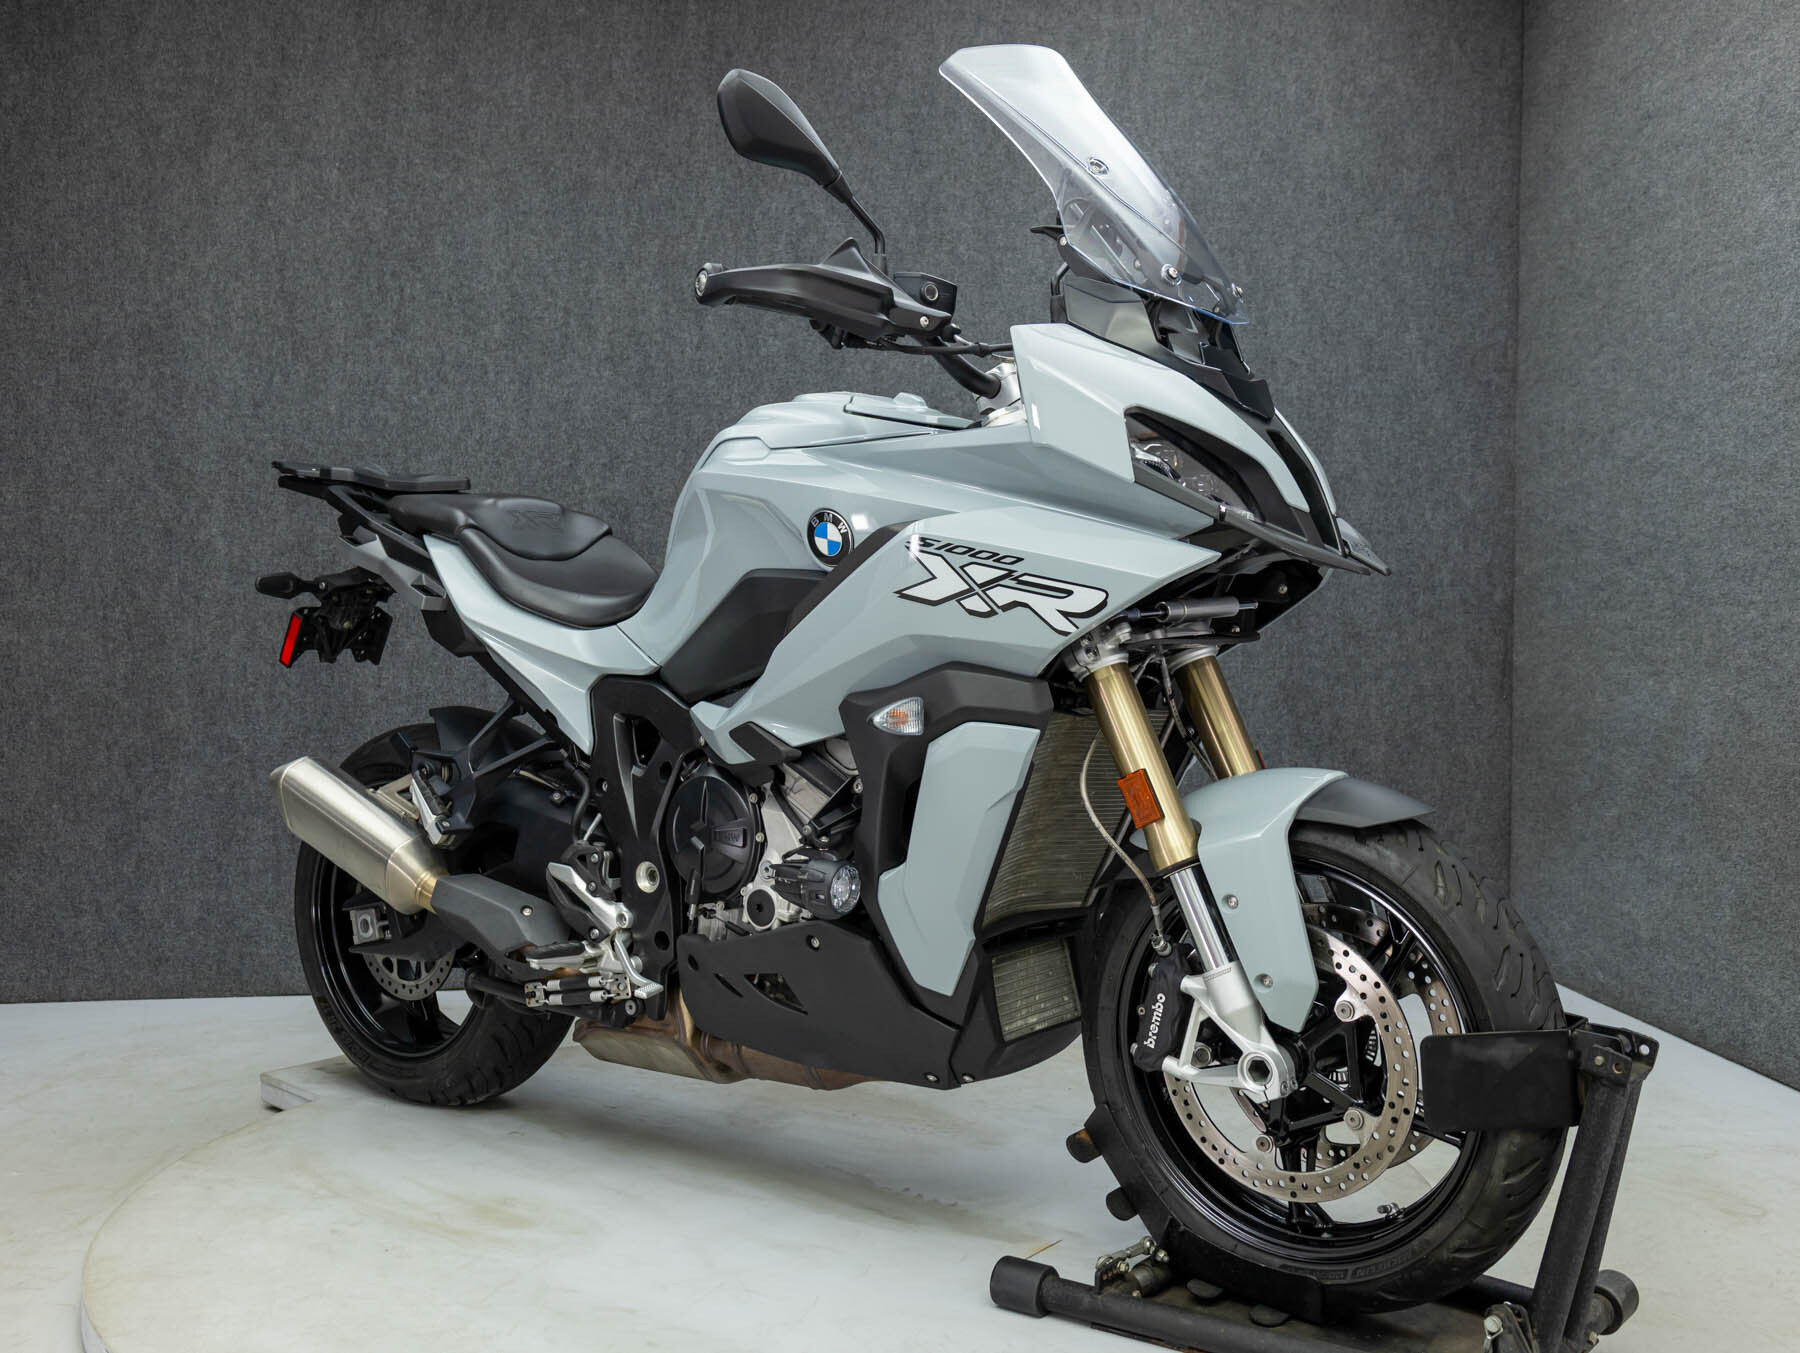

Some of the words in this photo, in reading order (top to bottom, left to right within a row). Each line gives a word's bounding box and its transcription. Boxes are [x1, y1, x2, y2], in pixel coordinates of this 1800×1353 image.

[810, 512, 848, 534] BMW
[905, 536, 1025, 565] S1000
[892, 549, 1109, 637] XR
[1143, 992, 1166, 1049] brembo
